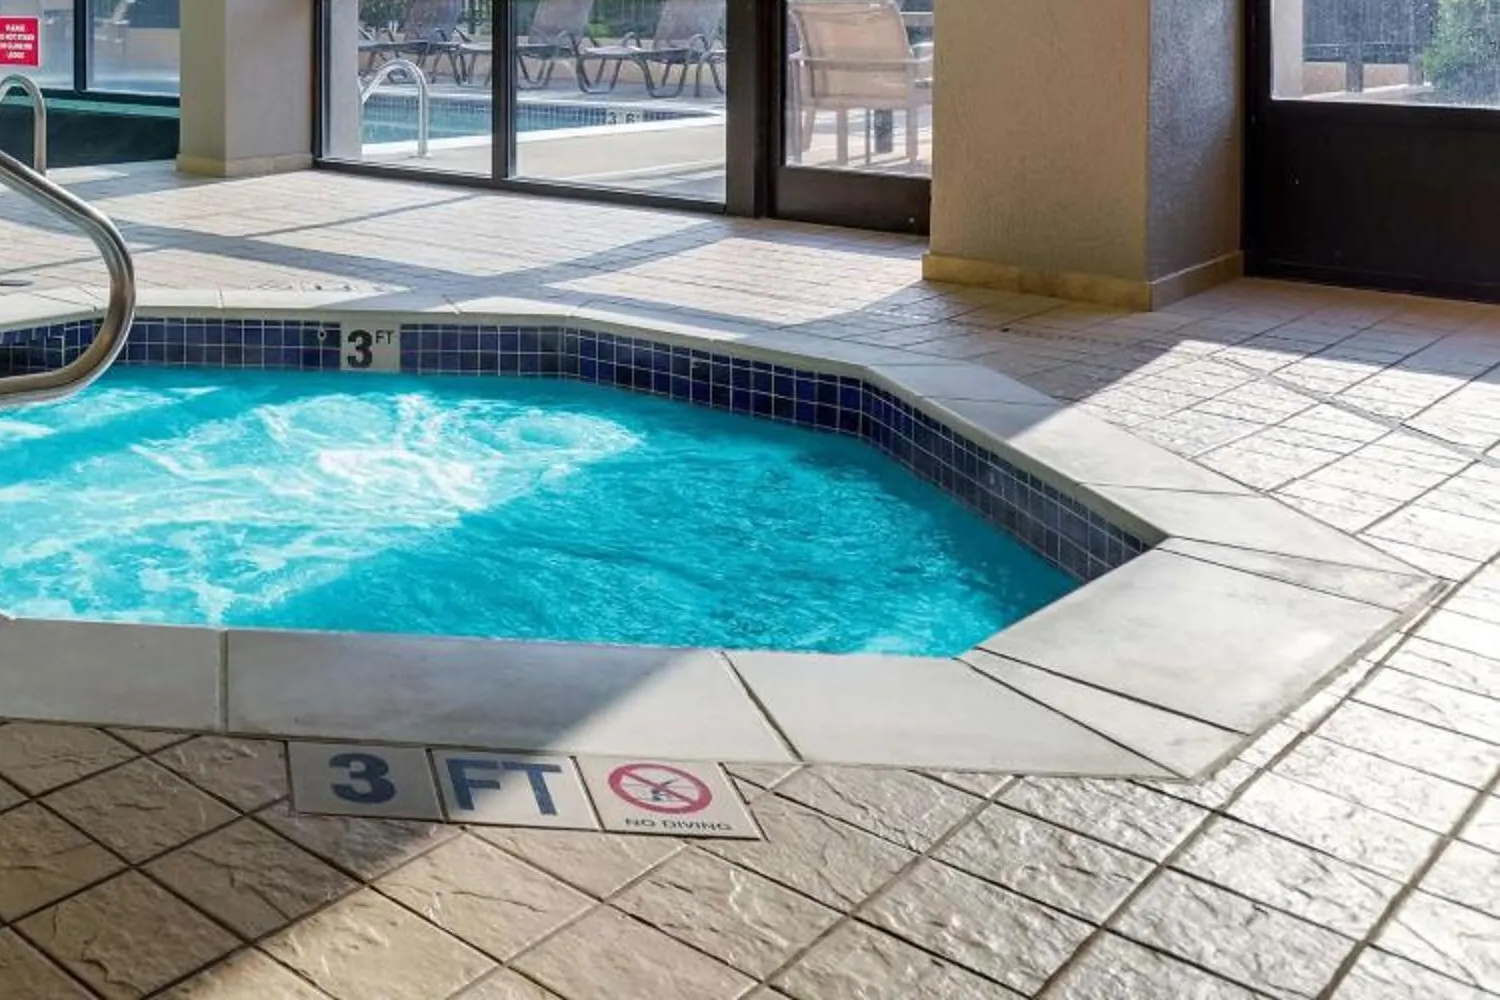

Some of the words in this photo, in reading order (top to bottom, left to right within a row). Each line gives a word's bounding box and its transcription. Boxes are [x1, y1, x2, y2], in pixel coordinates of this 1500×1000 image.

[347, 329, 373, 368] 3
[375, 330, 394, 345] FT
[329, 752, 398, 804] 3
[445, 758, 562, 816] FT
[625, 818, 656, 827] NO
[662, 820, 733, 831] DIVING
